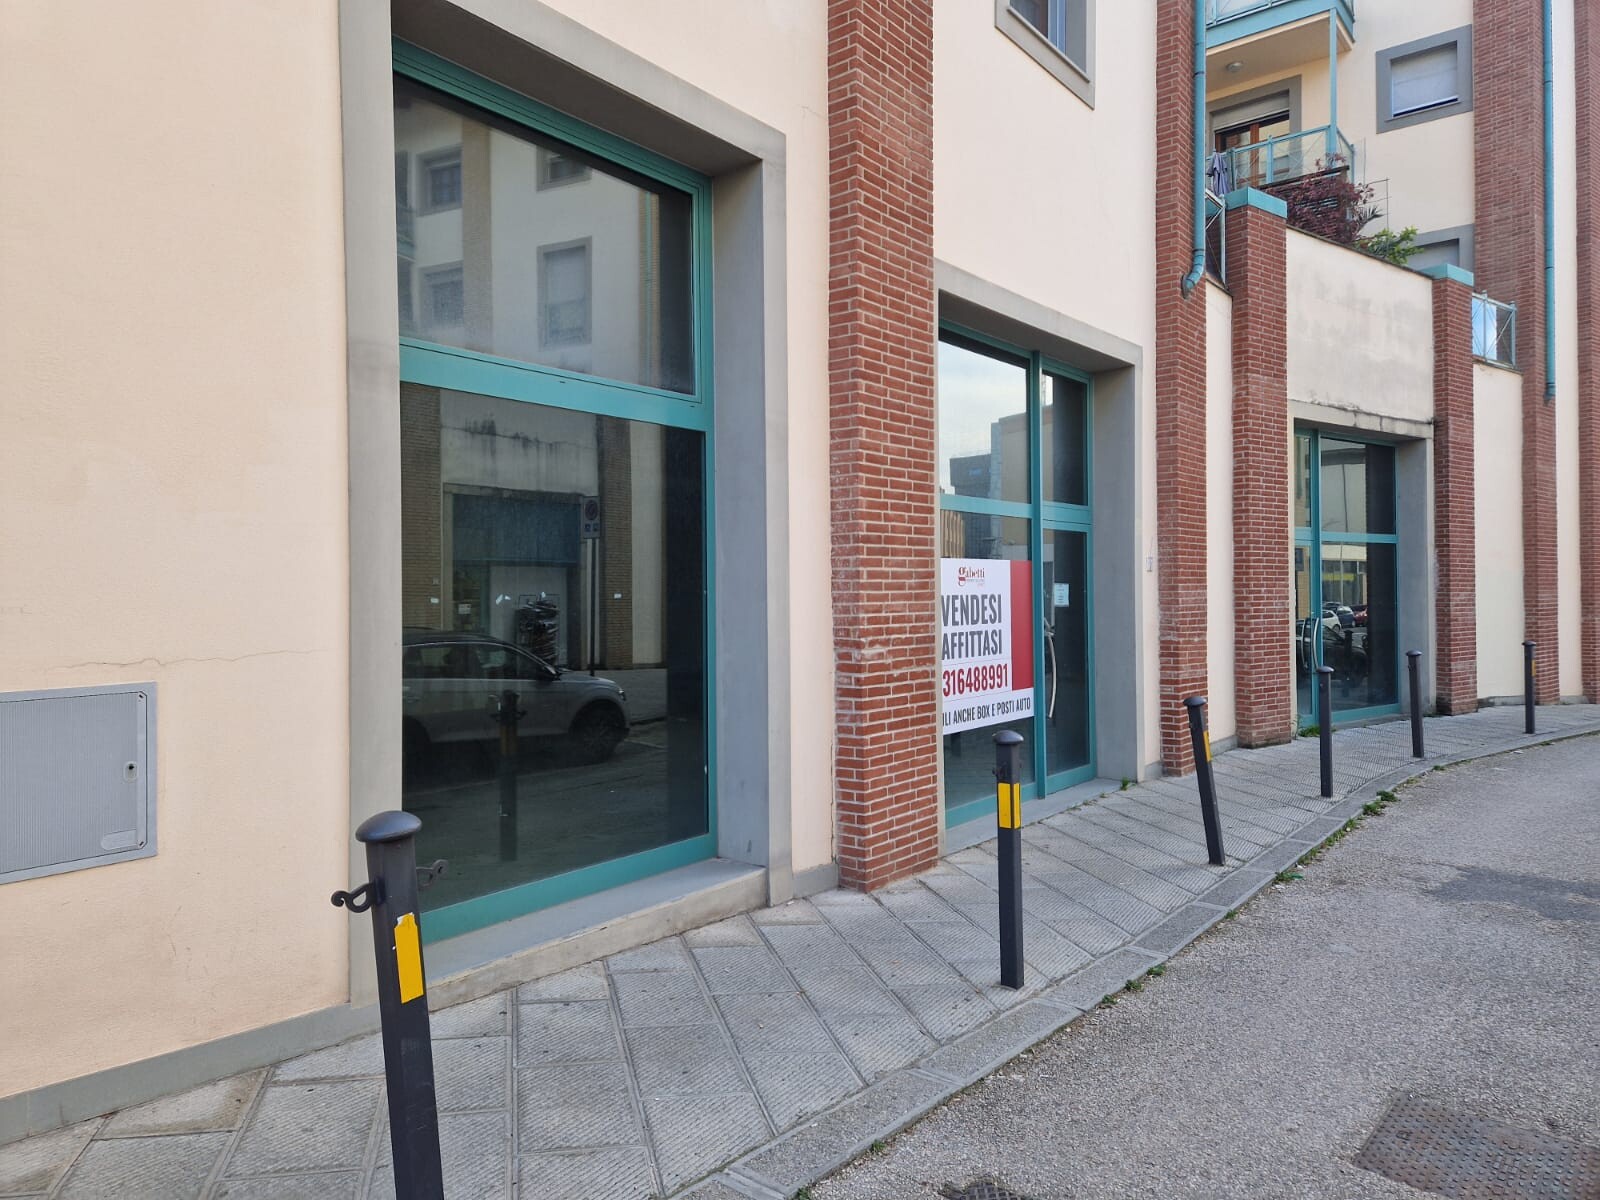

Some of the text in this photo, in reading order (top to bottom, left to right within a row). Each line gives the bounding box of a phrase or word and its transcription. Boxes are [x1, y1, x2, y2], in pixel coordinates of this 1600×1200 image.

[941, 594, 1002, 626] VENDESI
[942, 629, 1002, 660] AFFITTASI
[943, 663, 1008, 697] 316488991
[953, 707, 975, 725] ANCHE
[977, 704, 990, 719] BOX
[991, 703, 996, 717] E
[997, 700, 1014, 716] POSTI
[1015, 697, 1031, 711] AUTO
